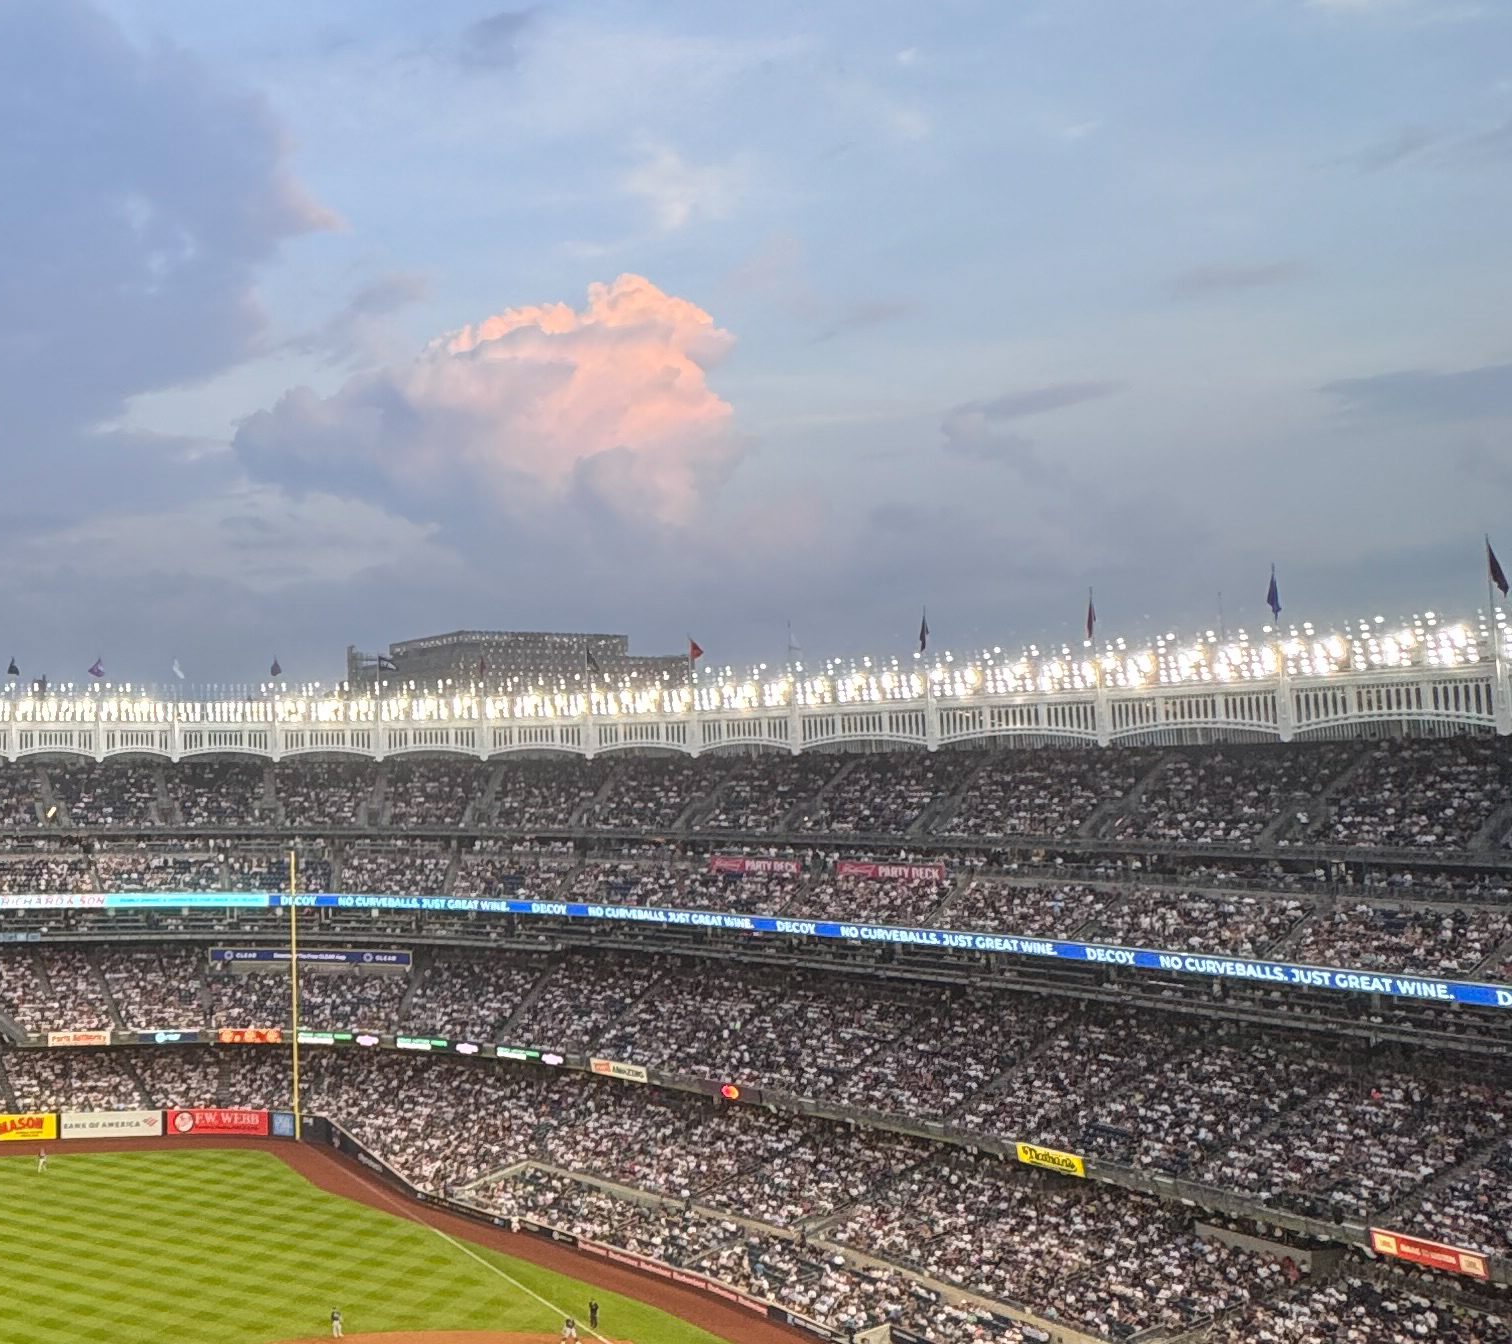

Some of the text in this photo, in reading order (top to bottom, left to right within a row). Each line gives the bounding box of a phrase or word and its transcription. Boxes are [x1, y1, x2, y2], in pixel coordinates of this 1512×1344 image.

[878, 866, 910, 879] PARTY
[338, 896, 354, 907] NO
[422, 899, 445, 909] JUST
[447, 899, 478, 910] GREAT
[531, 903, 567, 915] DECOY
[588, 906, 604, 917] NO
[668, 912, 689, 924] JUST
[691, 913, 722, 927] GREAT
[776, 920, 816, 934] DECOY
[840, 926, 1057, 956] NO CURVEBALLS. JUST GREAT WINE.
[1085, 947, 1136, 965] DECOY
[1159, 954, 1455, 1000] NO CURVEBALLS. JUST GREAT WINE.
[102, 1120, 140, 1128] AMERICA
[220, 1112, 259, 1125] WEBB
